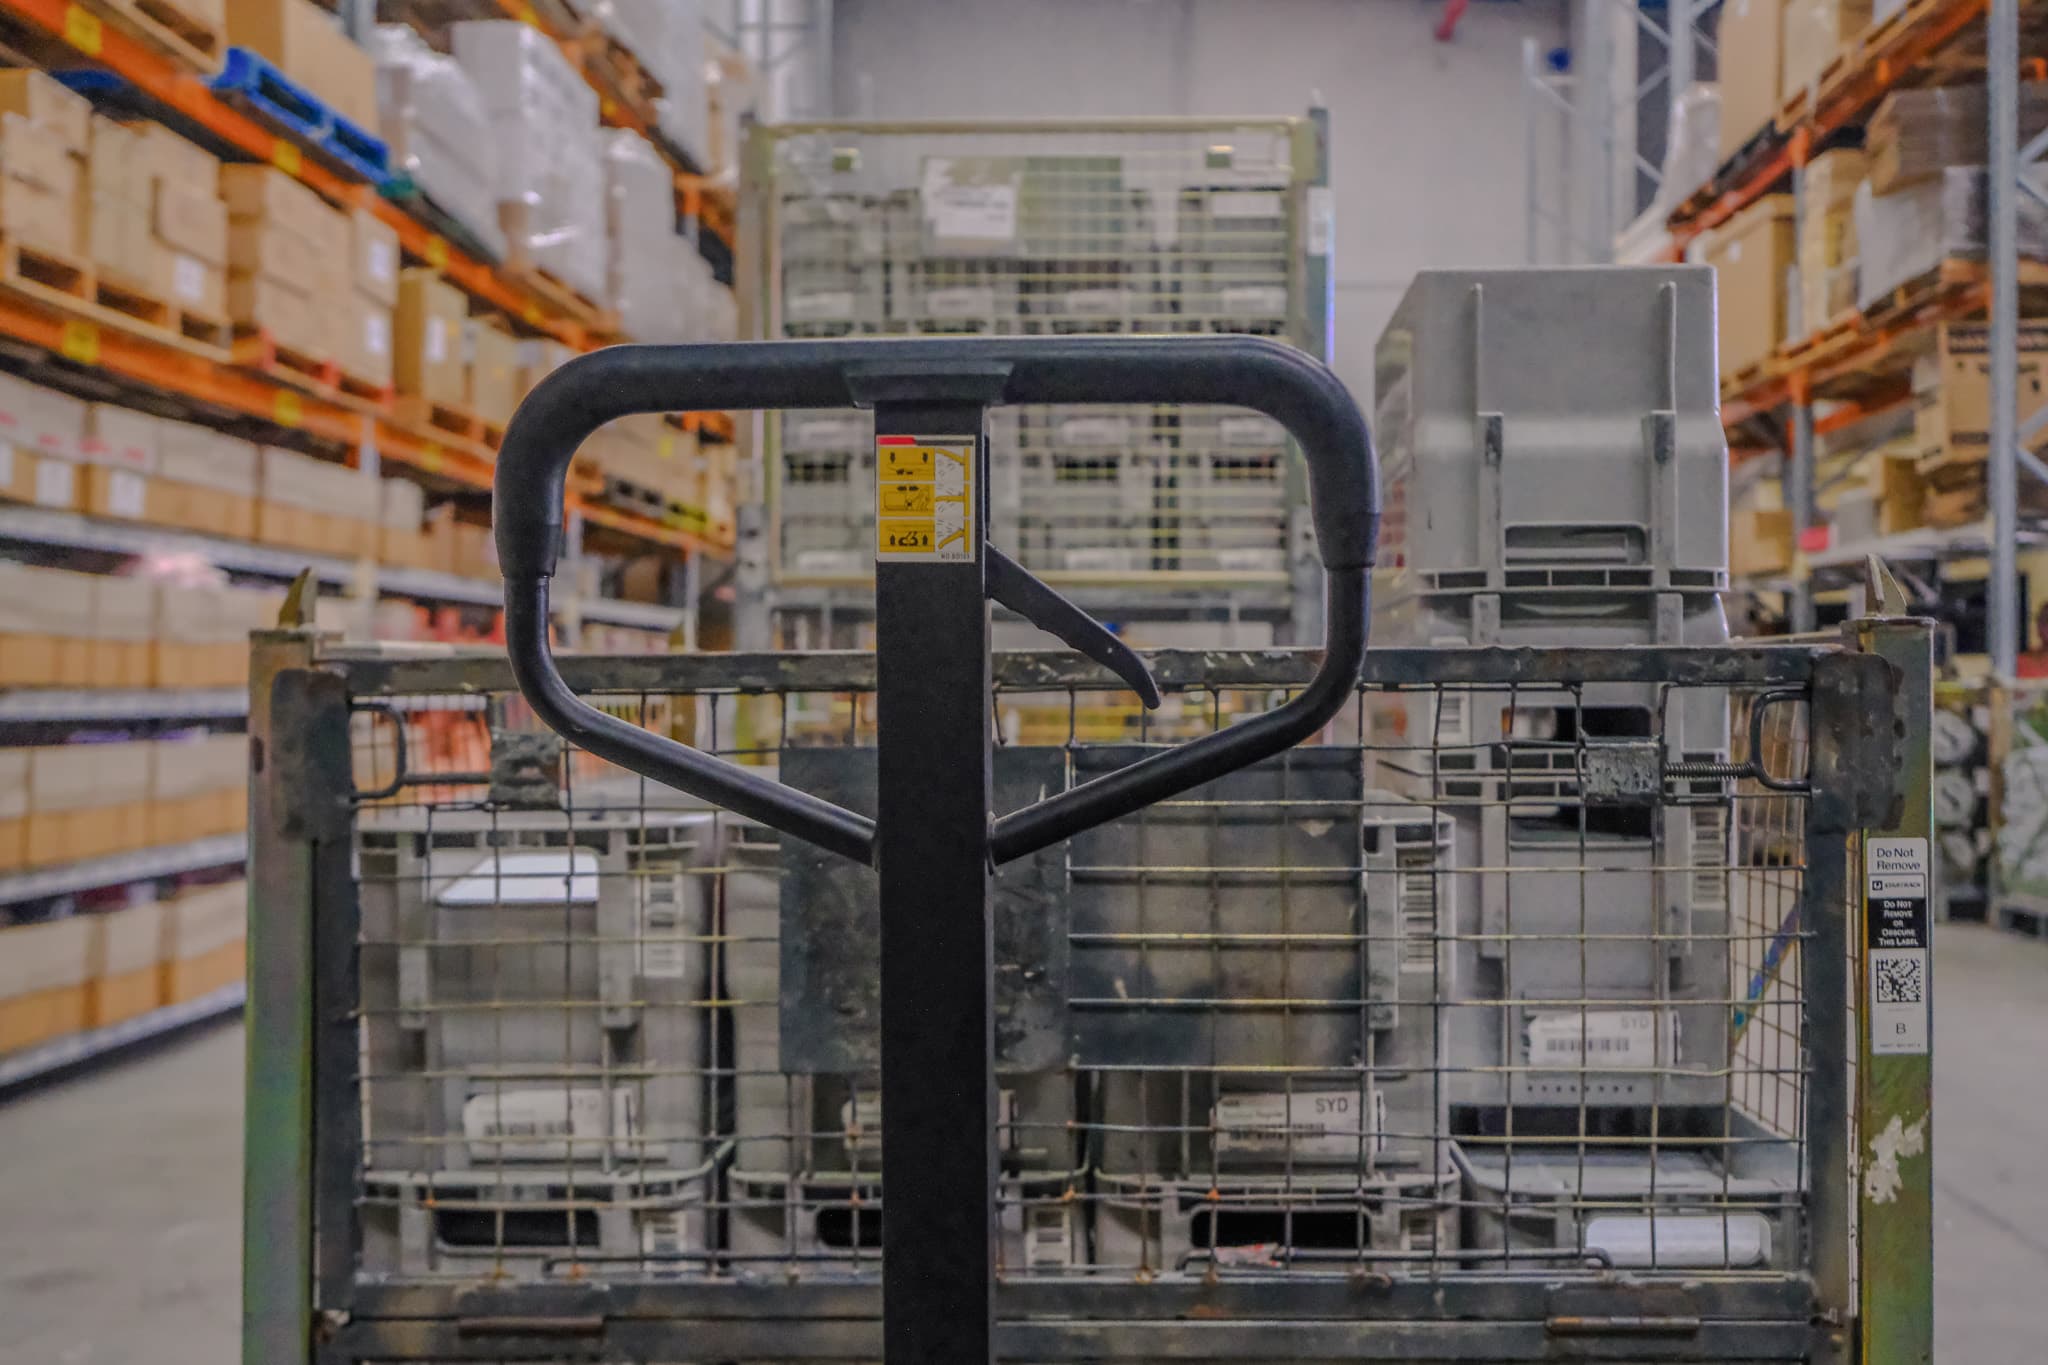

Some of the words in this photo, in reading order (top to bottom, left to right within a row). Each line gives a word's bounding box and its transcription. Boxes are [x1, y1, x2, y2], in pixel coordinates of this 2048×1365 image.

[1877, 848, 1892, 857] Do
[1894, 848, 1914, 857] Not
[1877, 861, 1920, 870] Remove
[1621, 1016, 1649, 1029] SYD
[1896, 1023, 1906, 1034] B
[1315, 1098, 1348, 1113] SYD
